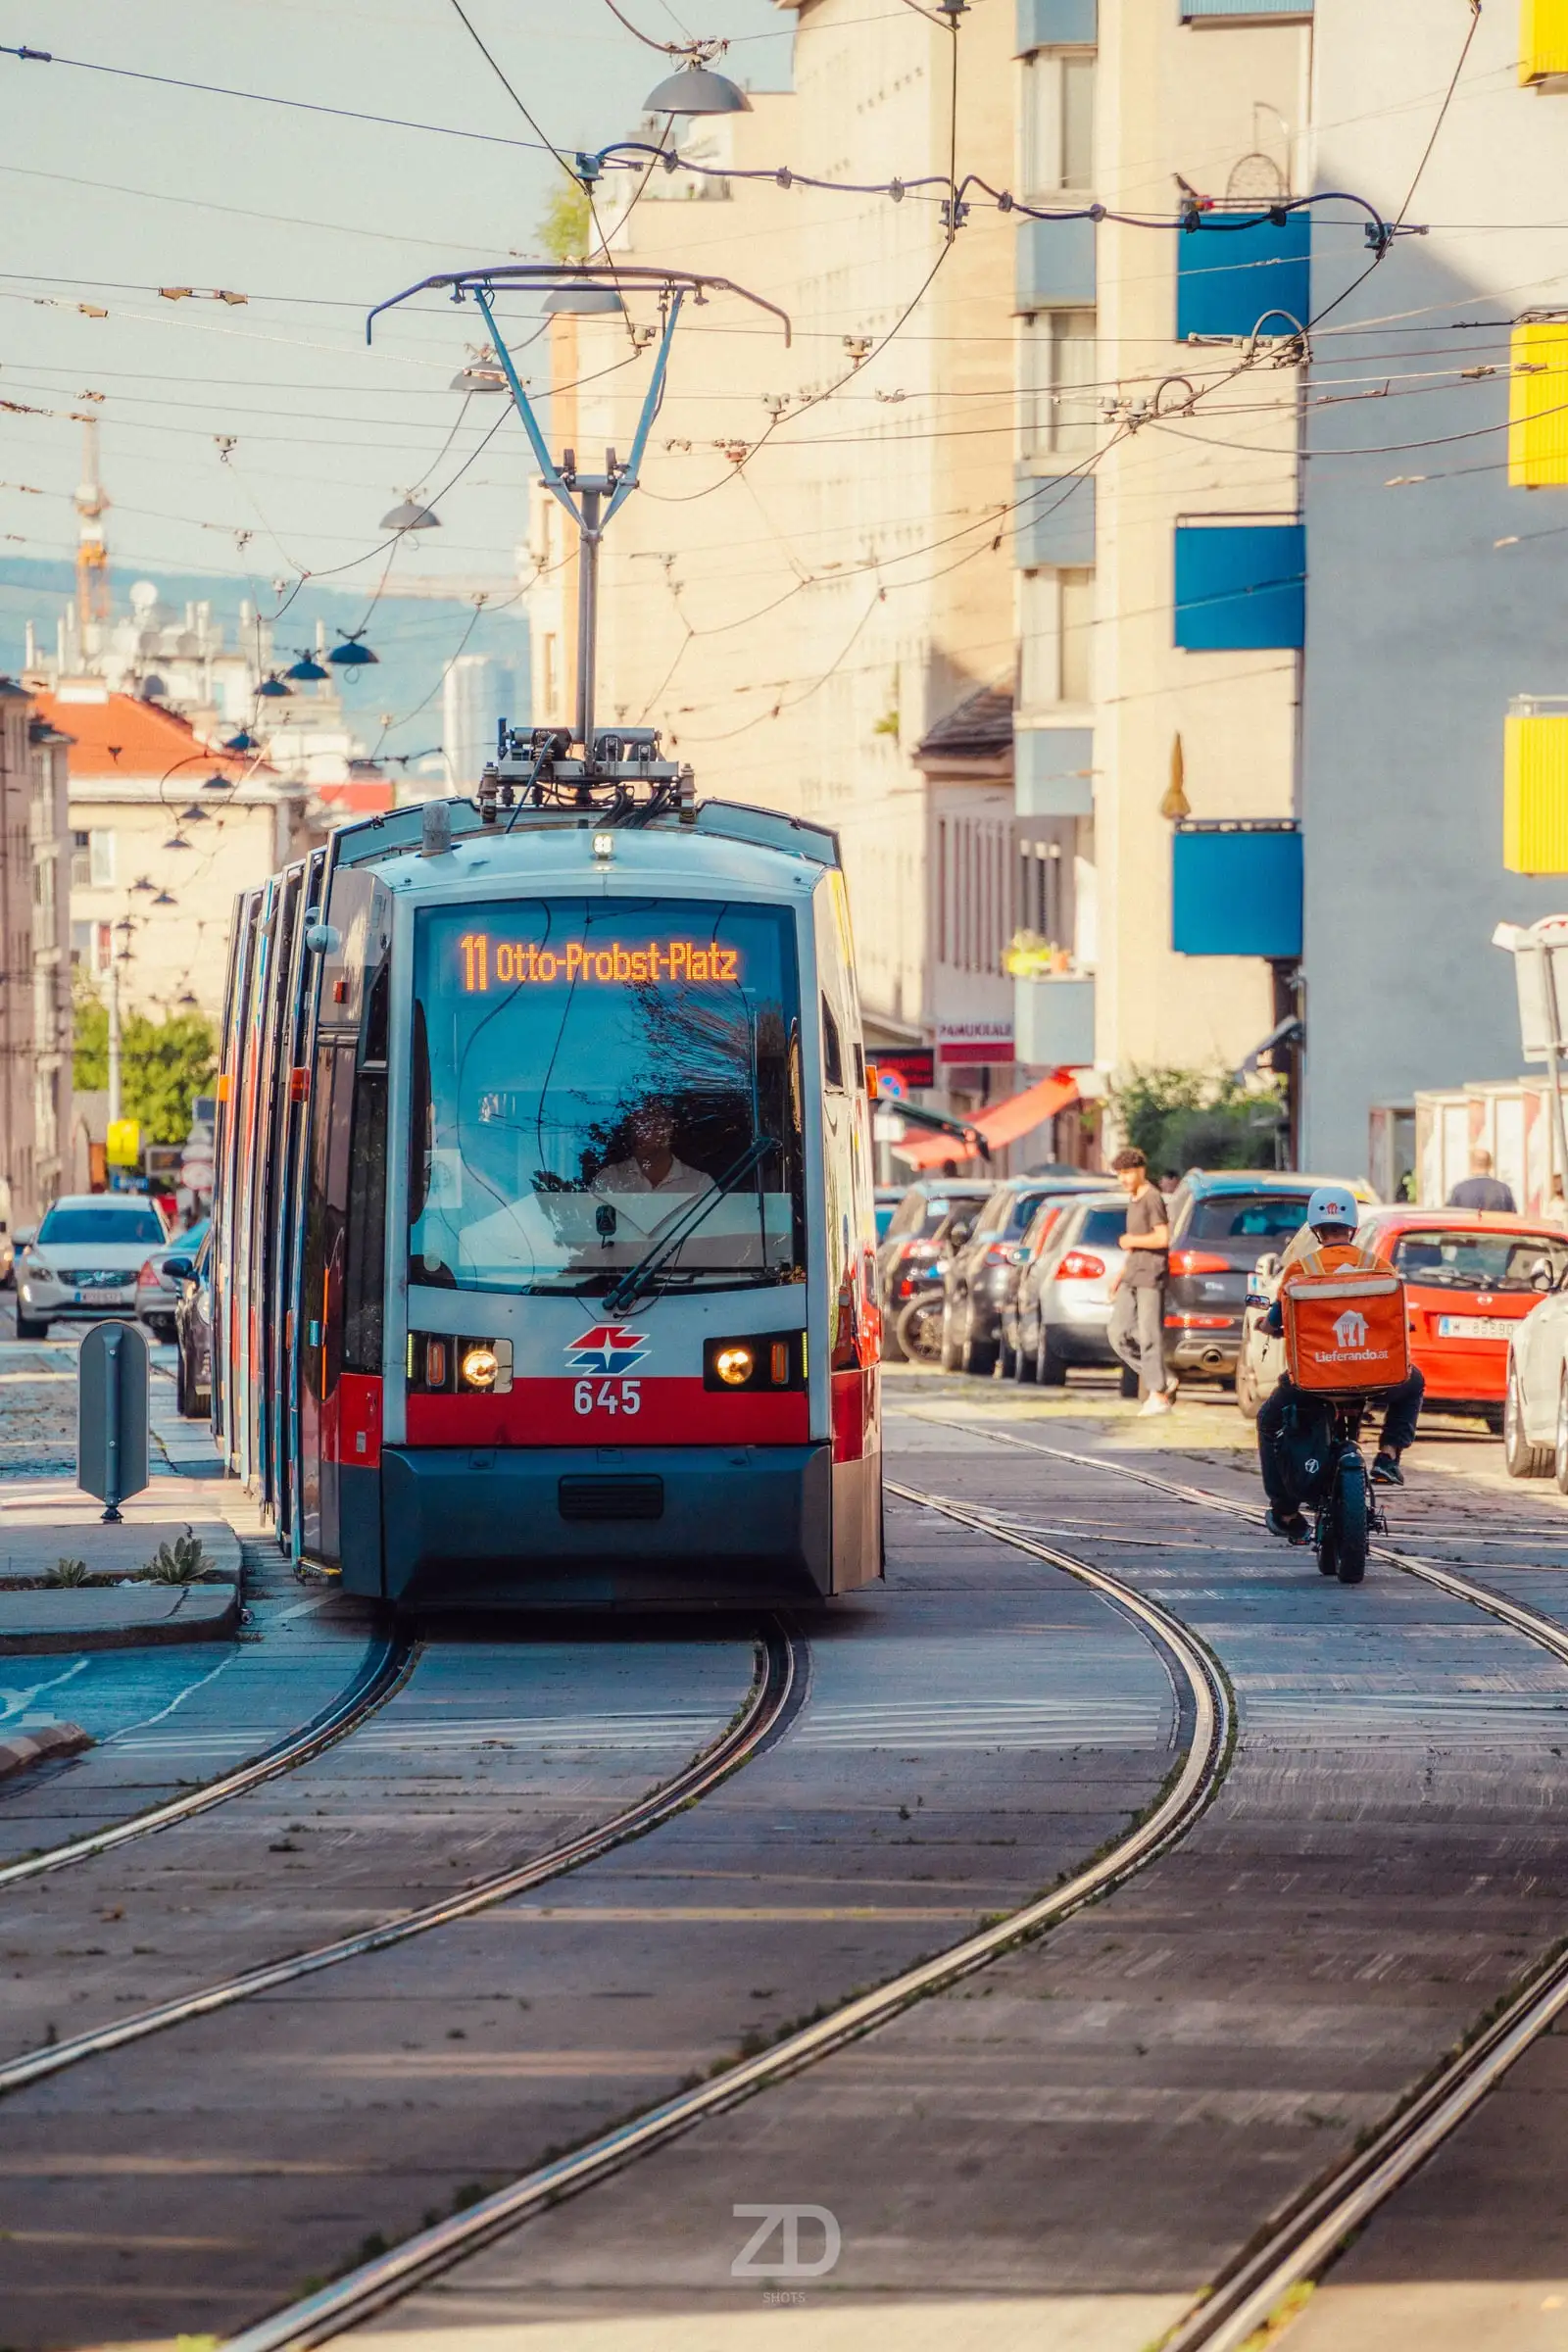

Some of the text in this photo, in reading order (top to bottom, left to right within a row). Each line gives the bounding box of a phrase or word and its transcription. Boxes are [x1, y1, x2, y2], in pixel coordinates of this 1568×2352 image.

[461, 935, 738, 991] 11 Otto-Probst-Platz
[1314, 1348, 1389, 1363] Lieferando.at
[573, 1380, 642, 1415] 645
